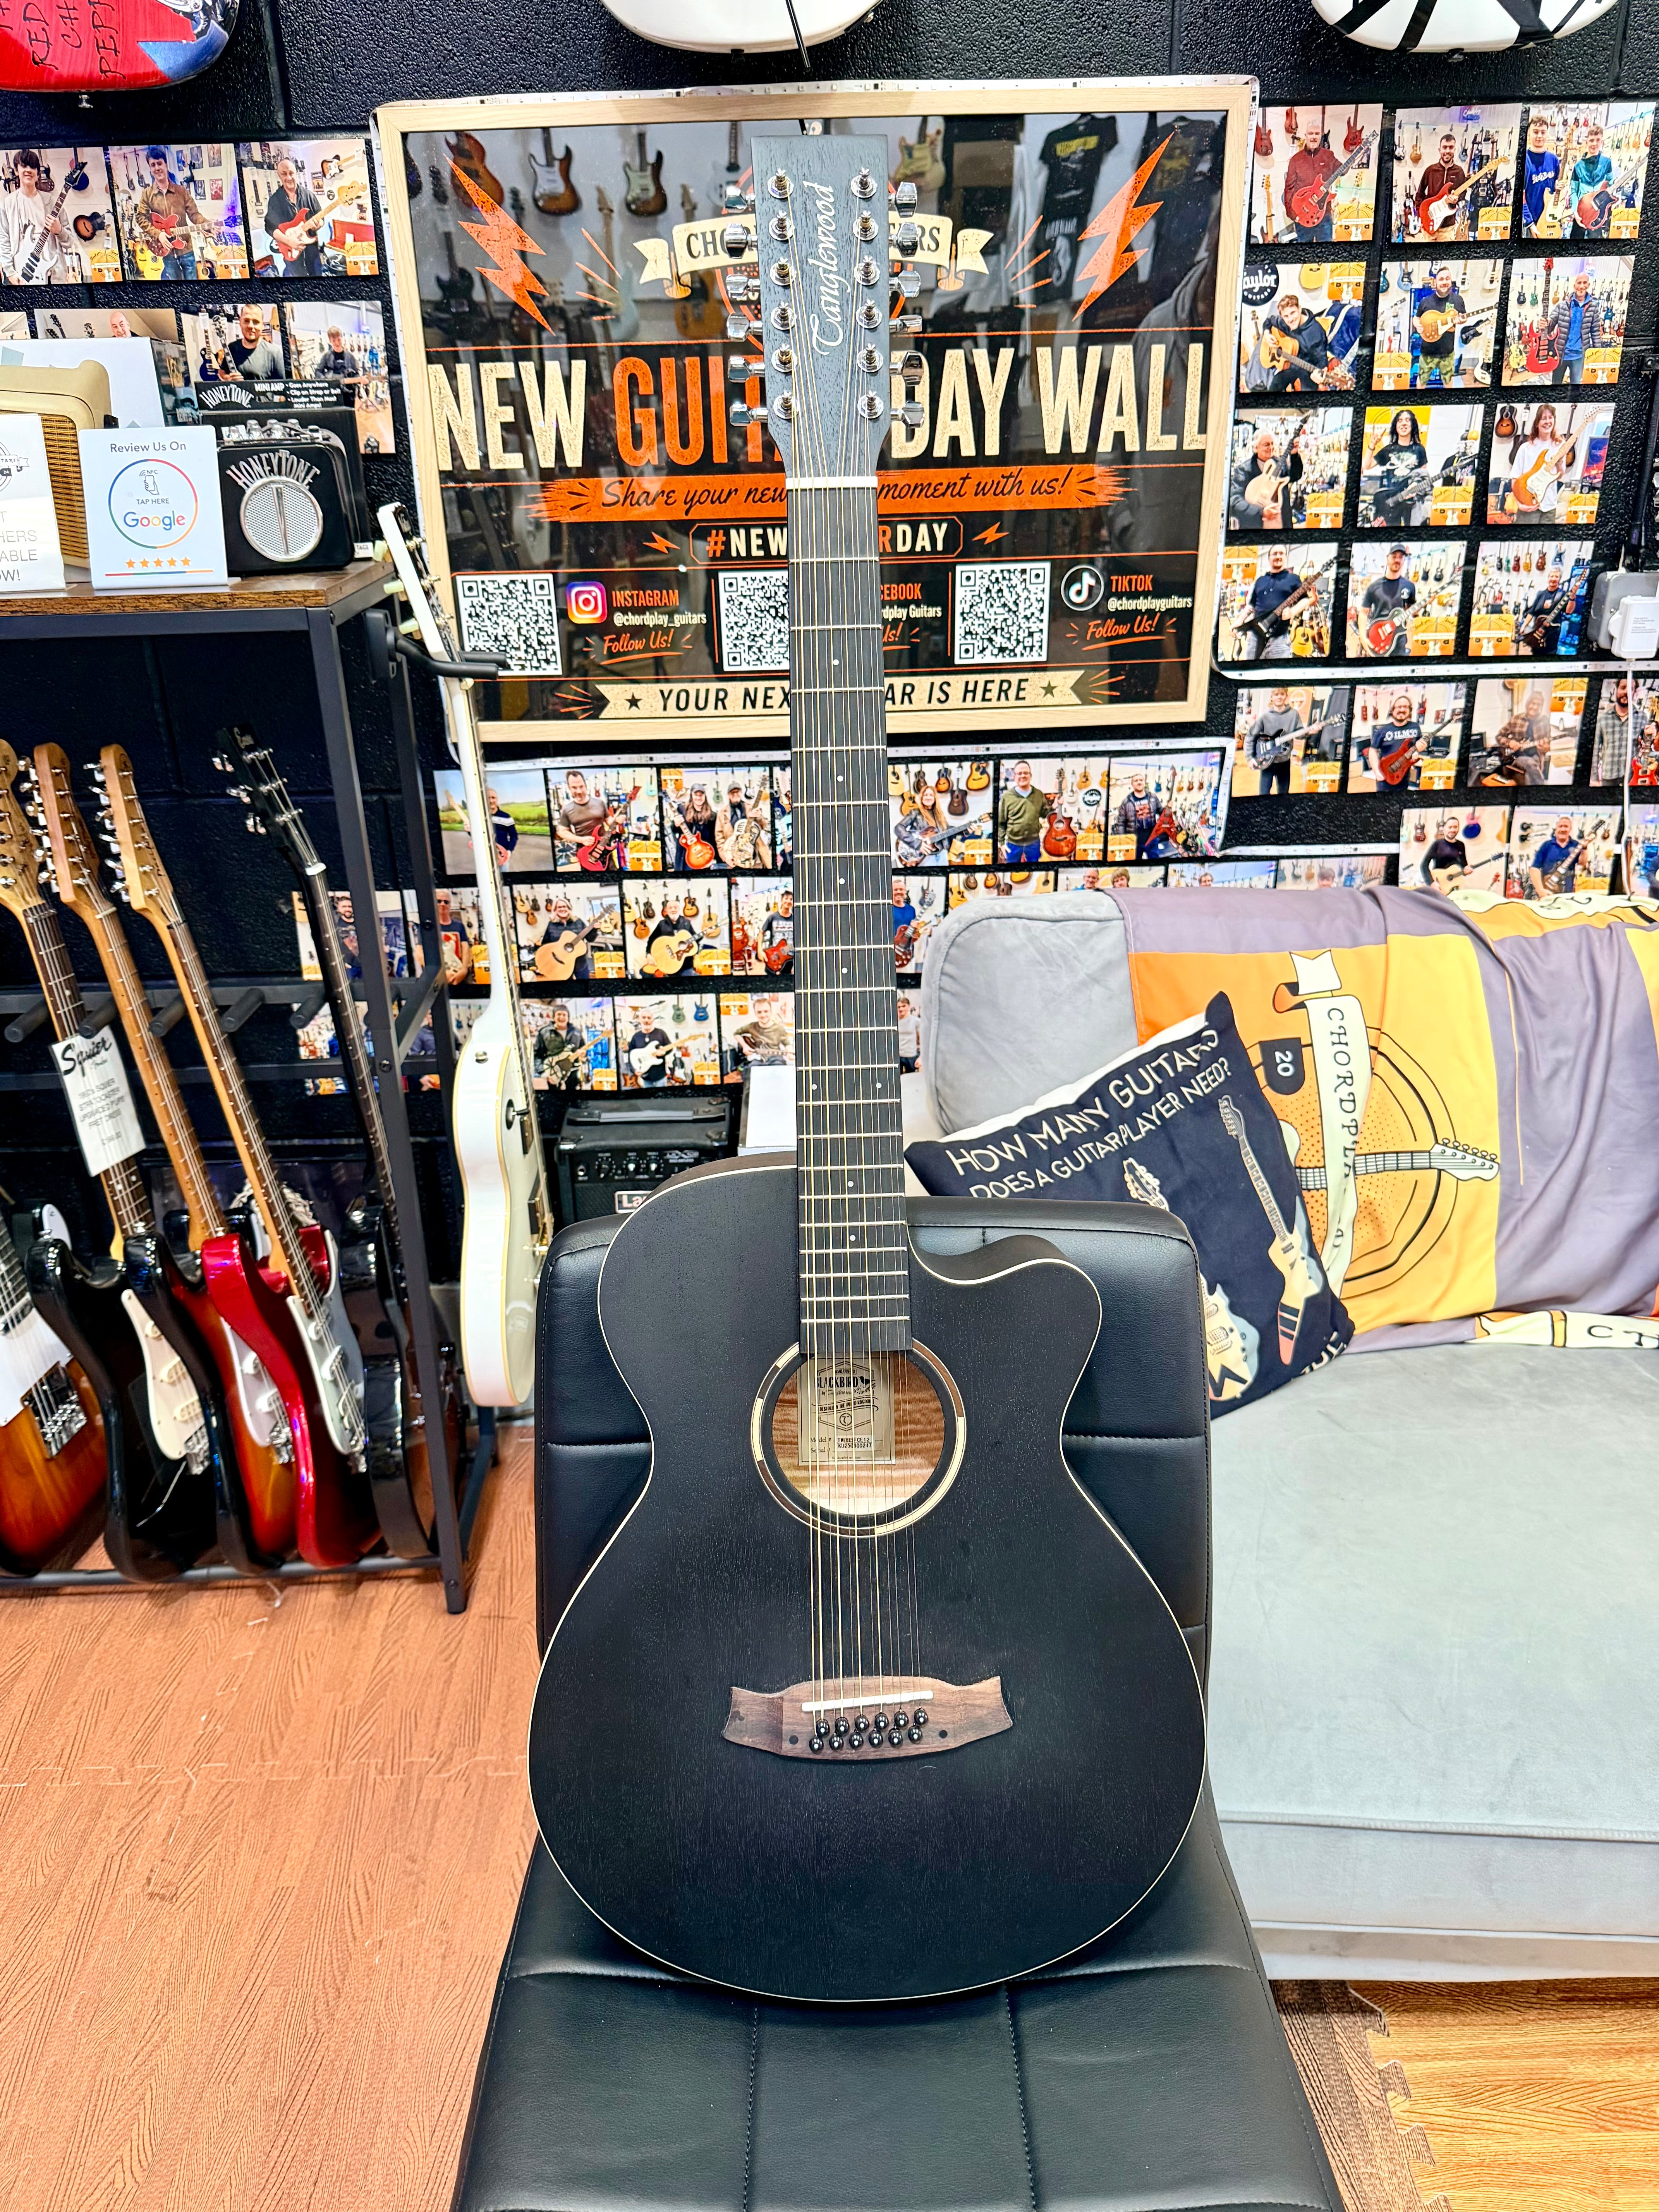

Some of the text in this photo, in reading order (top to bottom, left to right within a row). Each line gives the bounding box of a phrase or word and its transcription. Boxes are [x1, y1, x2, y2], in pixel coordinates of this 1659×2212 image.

[803, 180, 850, 355] Tanglewood
[199, 384, 254, 409] HONEYTONE
[428, 343, 1207, 471] NEW GUIT DAY WALL
[110, 441, 186, 452] Review Us On
[225, 449, 321, 491] HONEYTONE
[602, 467, 1073, 516] Share your new moment with us!
[124, 510, 185, 531] Google
[0, 569, 21, 581] W!
[1110, 575, 1153, 592] TIKTOK
[612, 590, 679, 607] INSTAGRAM
[909, 603, 942, 618] Guitars
[1108, 595, 1194, 612] @chordplayguitars
[613, 610, 707, 628] @chordplay_guitars
[1086, 612, 1161, 641] Follow Us!
[603, 629, 674, 654] Follow Us!
[659, 688, 728, 711] YOUR
[743, 686, 790, 710] NEX
[927, 681, 951, 704] IS
[962, 678, 1029, 703] HERE
[61, 1037, 112, 1078] Squier
[1274, 1050, 1295, 1077] 20
[945, 1133, 1028, 1176] HOW
[1026, 1097, 1110, 1151] MANY
[969, 1171, 1036, 1198] DOES
[1035, 1168, 1054, 1187] A
[1180, 1057, 1232, 1104] NEED?
[815, 1376, 858, 1388] BLACKBIRD
